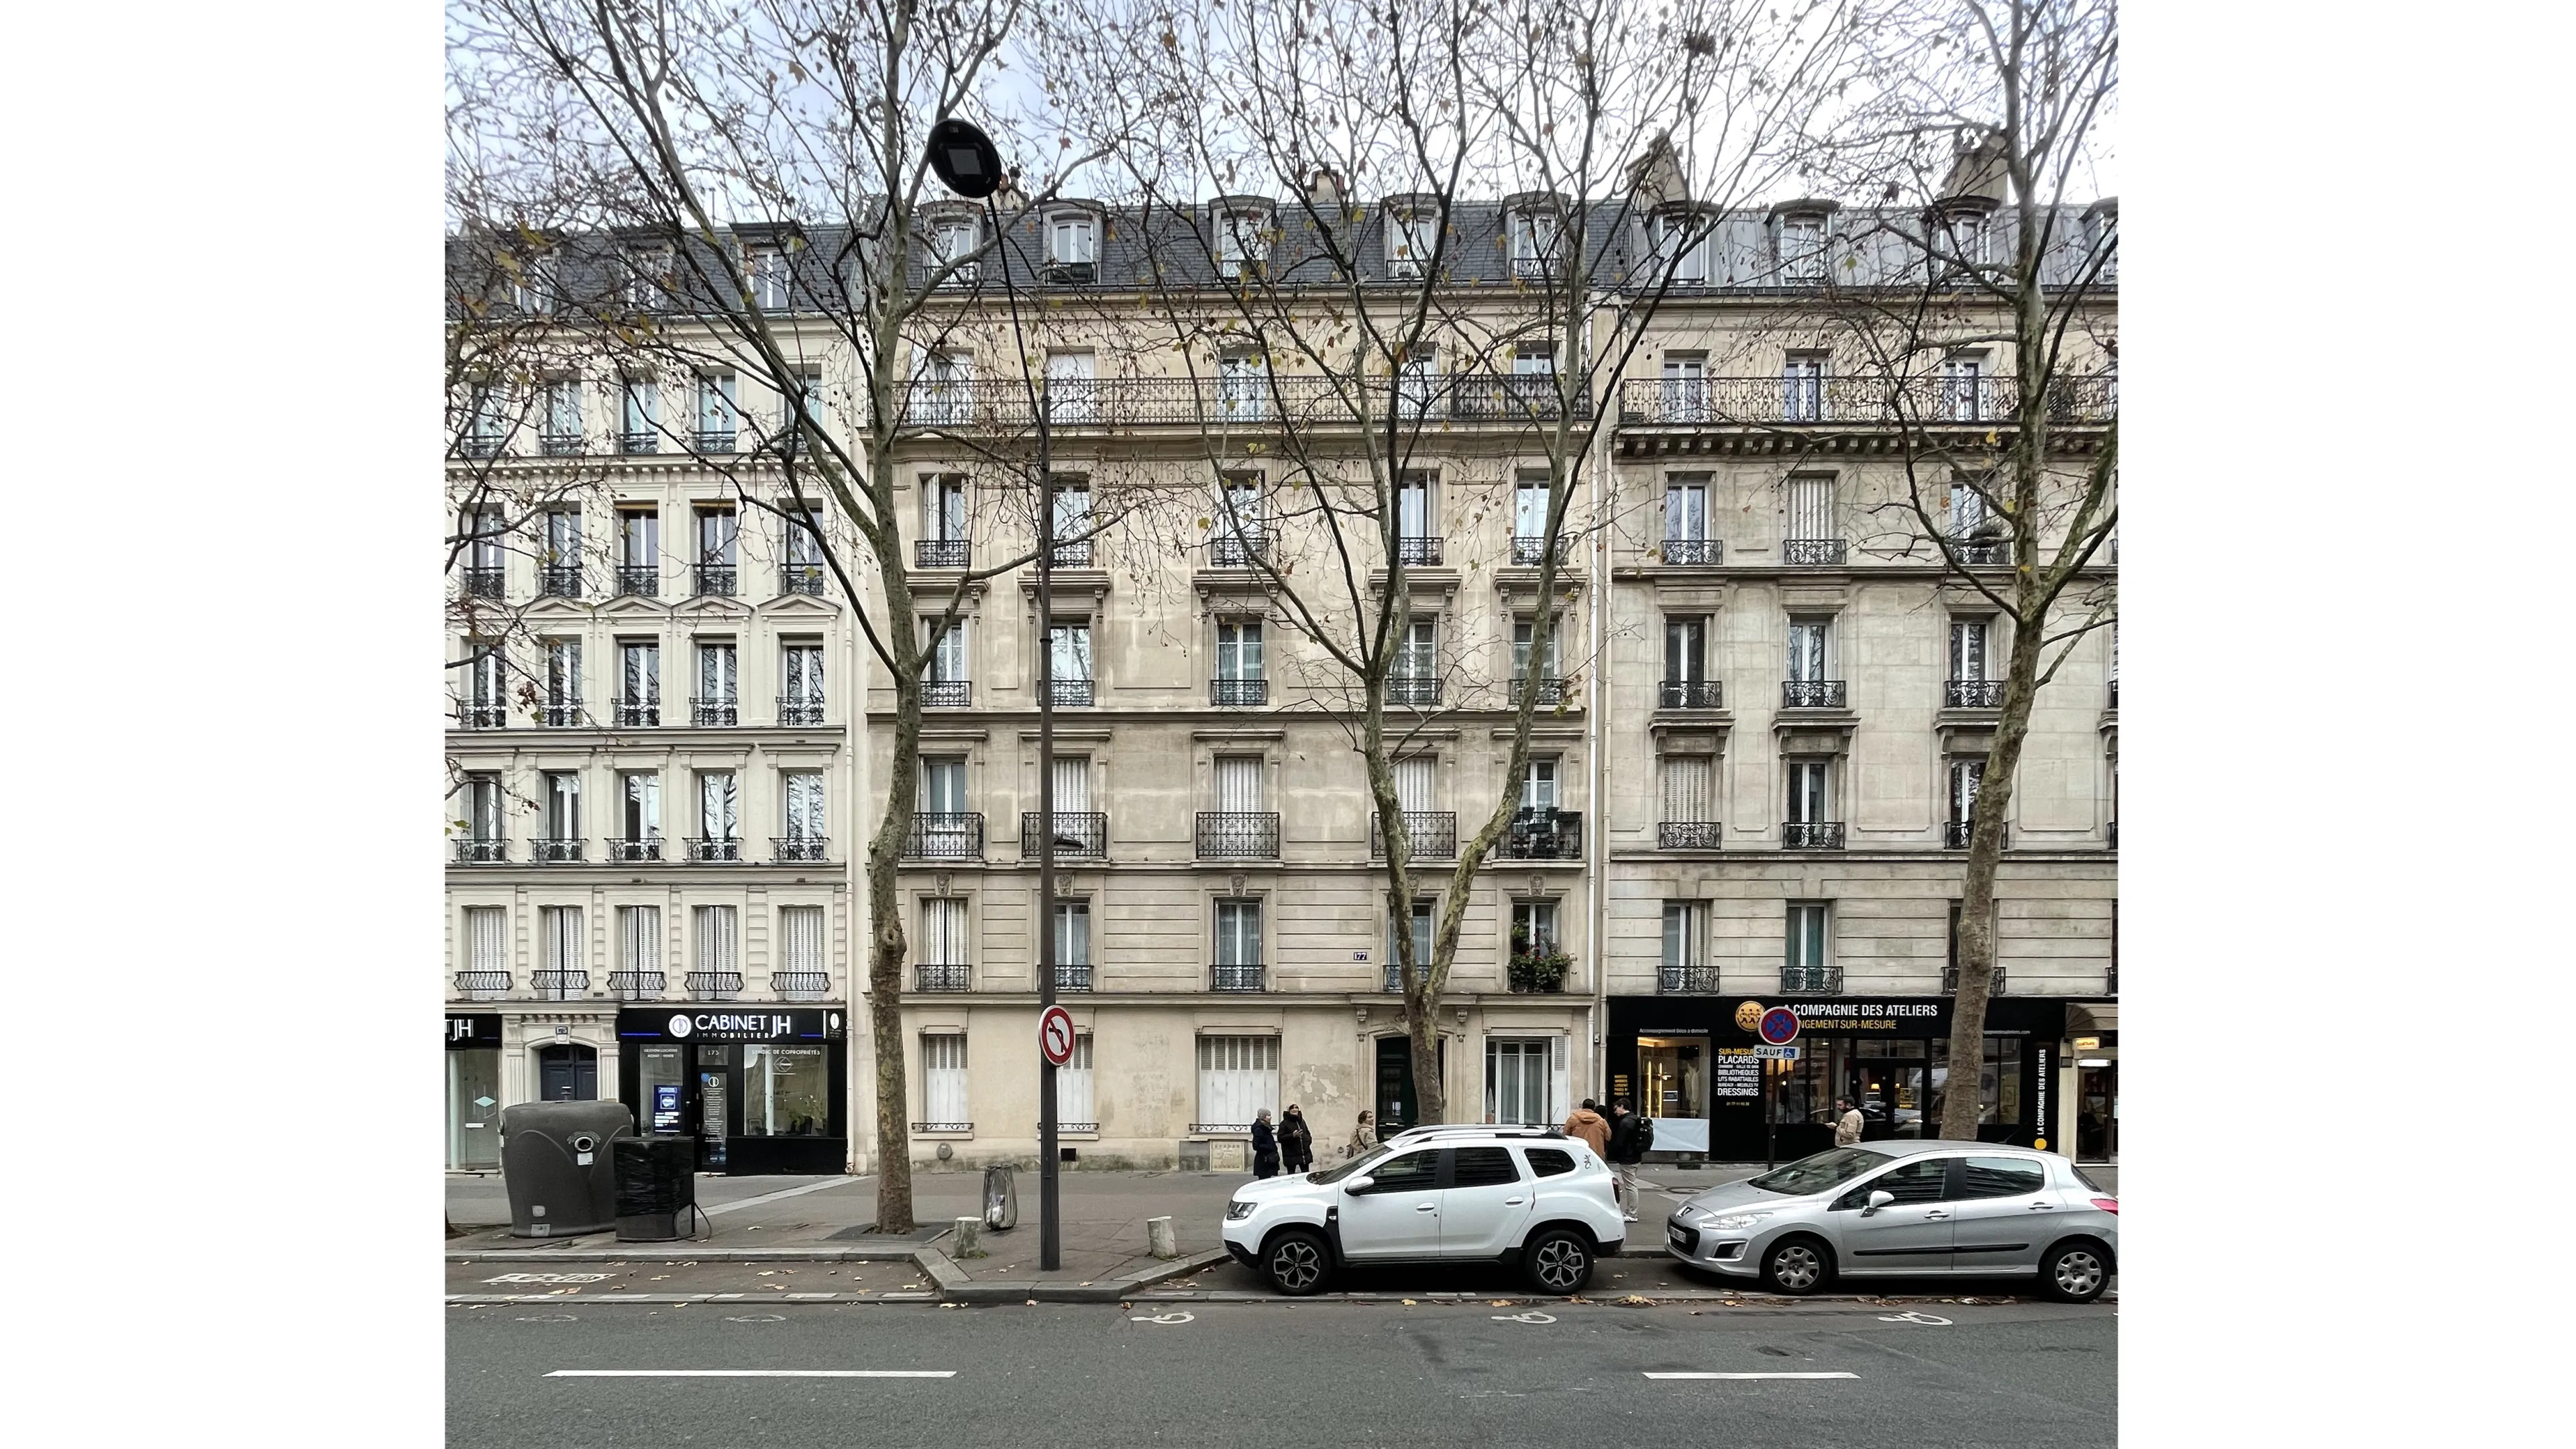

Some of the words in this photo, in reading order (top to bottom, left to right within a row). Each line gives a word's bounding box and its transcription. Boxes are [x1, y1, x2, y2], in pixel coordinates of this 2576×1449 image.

[1793, 1004, 1858, 1016] COMPAGNIE
[1862, 1004, 1883, 1016] DES
[1886, 1005, 1937, 1016] ATELIERS
[453, 1019, 474, 1041] JH
[695, 1014, 768, 1030] CABINET
[771, 1015, 791, 1038] JH
[1799, 1020, 1839, 1029] NGEMENT
[1840, 1020, 1896, 1029] SUR-MESURE
[1756, 1048, 1782, 1057] SAUF
[1718, 1055, 1760, 1064] PLACARDS
[2038, 1049, 2046, 1077] ATELIERS
[2038, 1077, 2046, 1090] DES
[1717, 1087, 1759, 1096] DRESSINGS
[2037, 1091, 2045, 1126] COMPAGNIE
[2037, 1127, 2045, 1135] LA
